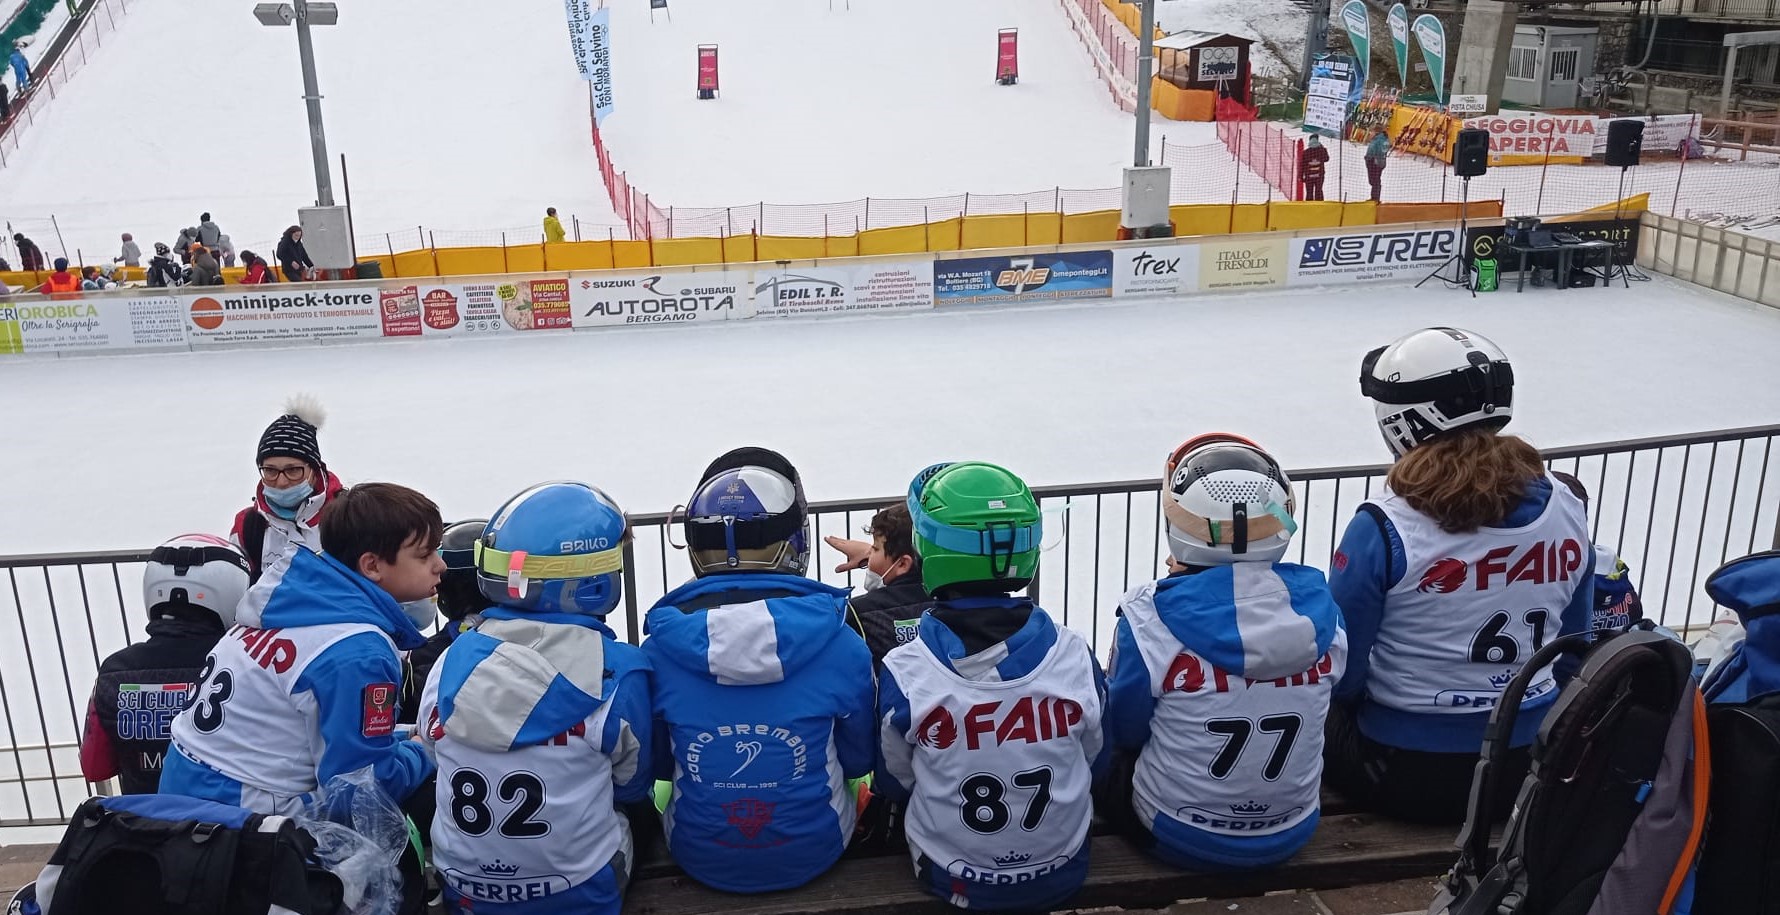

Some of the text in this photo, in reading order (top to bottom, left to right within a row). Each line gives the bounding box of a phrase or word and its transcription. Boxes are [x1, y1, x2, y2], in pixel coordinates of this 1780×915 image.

[590, 24, 604, 108] Sci Club Selvino
[602, 47, 612, 106] TONI MORANDI
[1464, 118, 1594, 134] SEGGIOVIA
[1489, 137, 1570, 152] APERTA
[1132, 251, 1180, 276] trex
[1216, 258, 1268, 271] TRESOLDI
[1218, 250, 1251, 261] ITALO
[996, 268, 1050, 287] BME
[1053, 268, 1107, 278] bmeponteggi.it
[533, 283, 566, 291] AVIATICO
[593, 280, 635, 288] SUZUKI
[694, 286, 736, 295] SUBARU
[780, 287, 844, 299] EDIL T. R.
[225, 292, 372, 311] minipack-torre
[584, 296, 734, 317] AUTOROTA
[319, 309, 374, 318] TERMORETRAIBILE
[626, 313, 696, 323] BERGAMO
[22, 317, 100, 332] Oltre la Serigrafia
[560, 537, 608, 553] BRIKO
[1475, 538, 1582, 591] FAIP
[895, 626, 921, 644] SCI
[1468, 608, 1549, 664] 61
[117, 690, 189, 710] SCI CLUB
[117, 709, 180, 740] ORE
[964, 696, 1083, 750] FAIP
[1204, 712, 1304, 782] 77
[448, 767, 552, 839] 82
[959, 765, 1054, 835] 87
